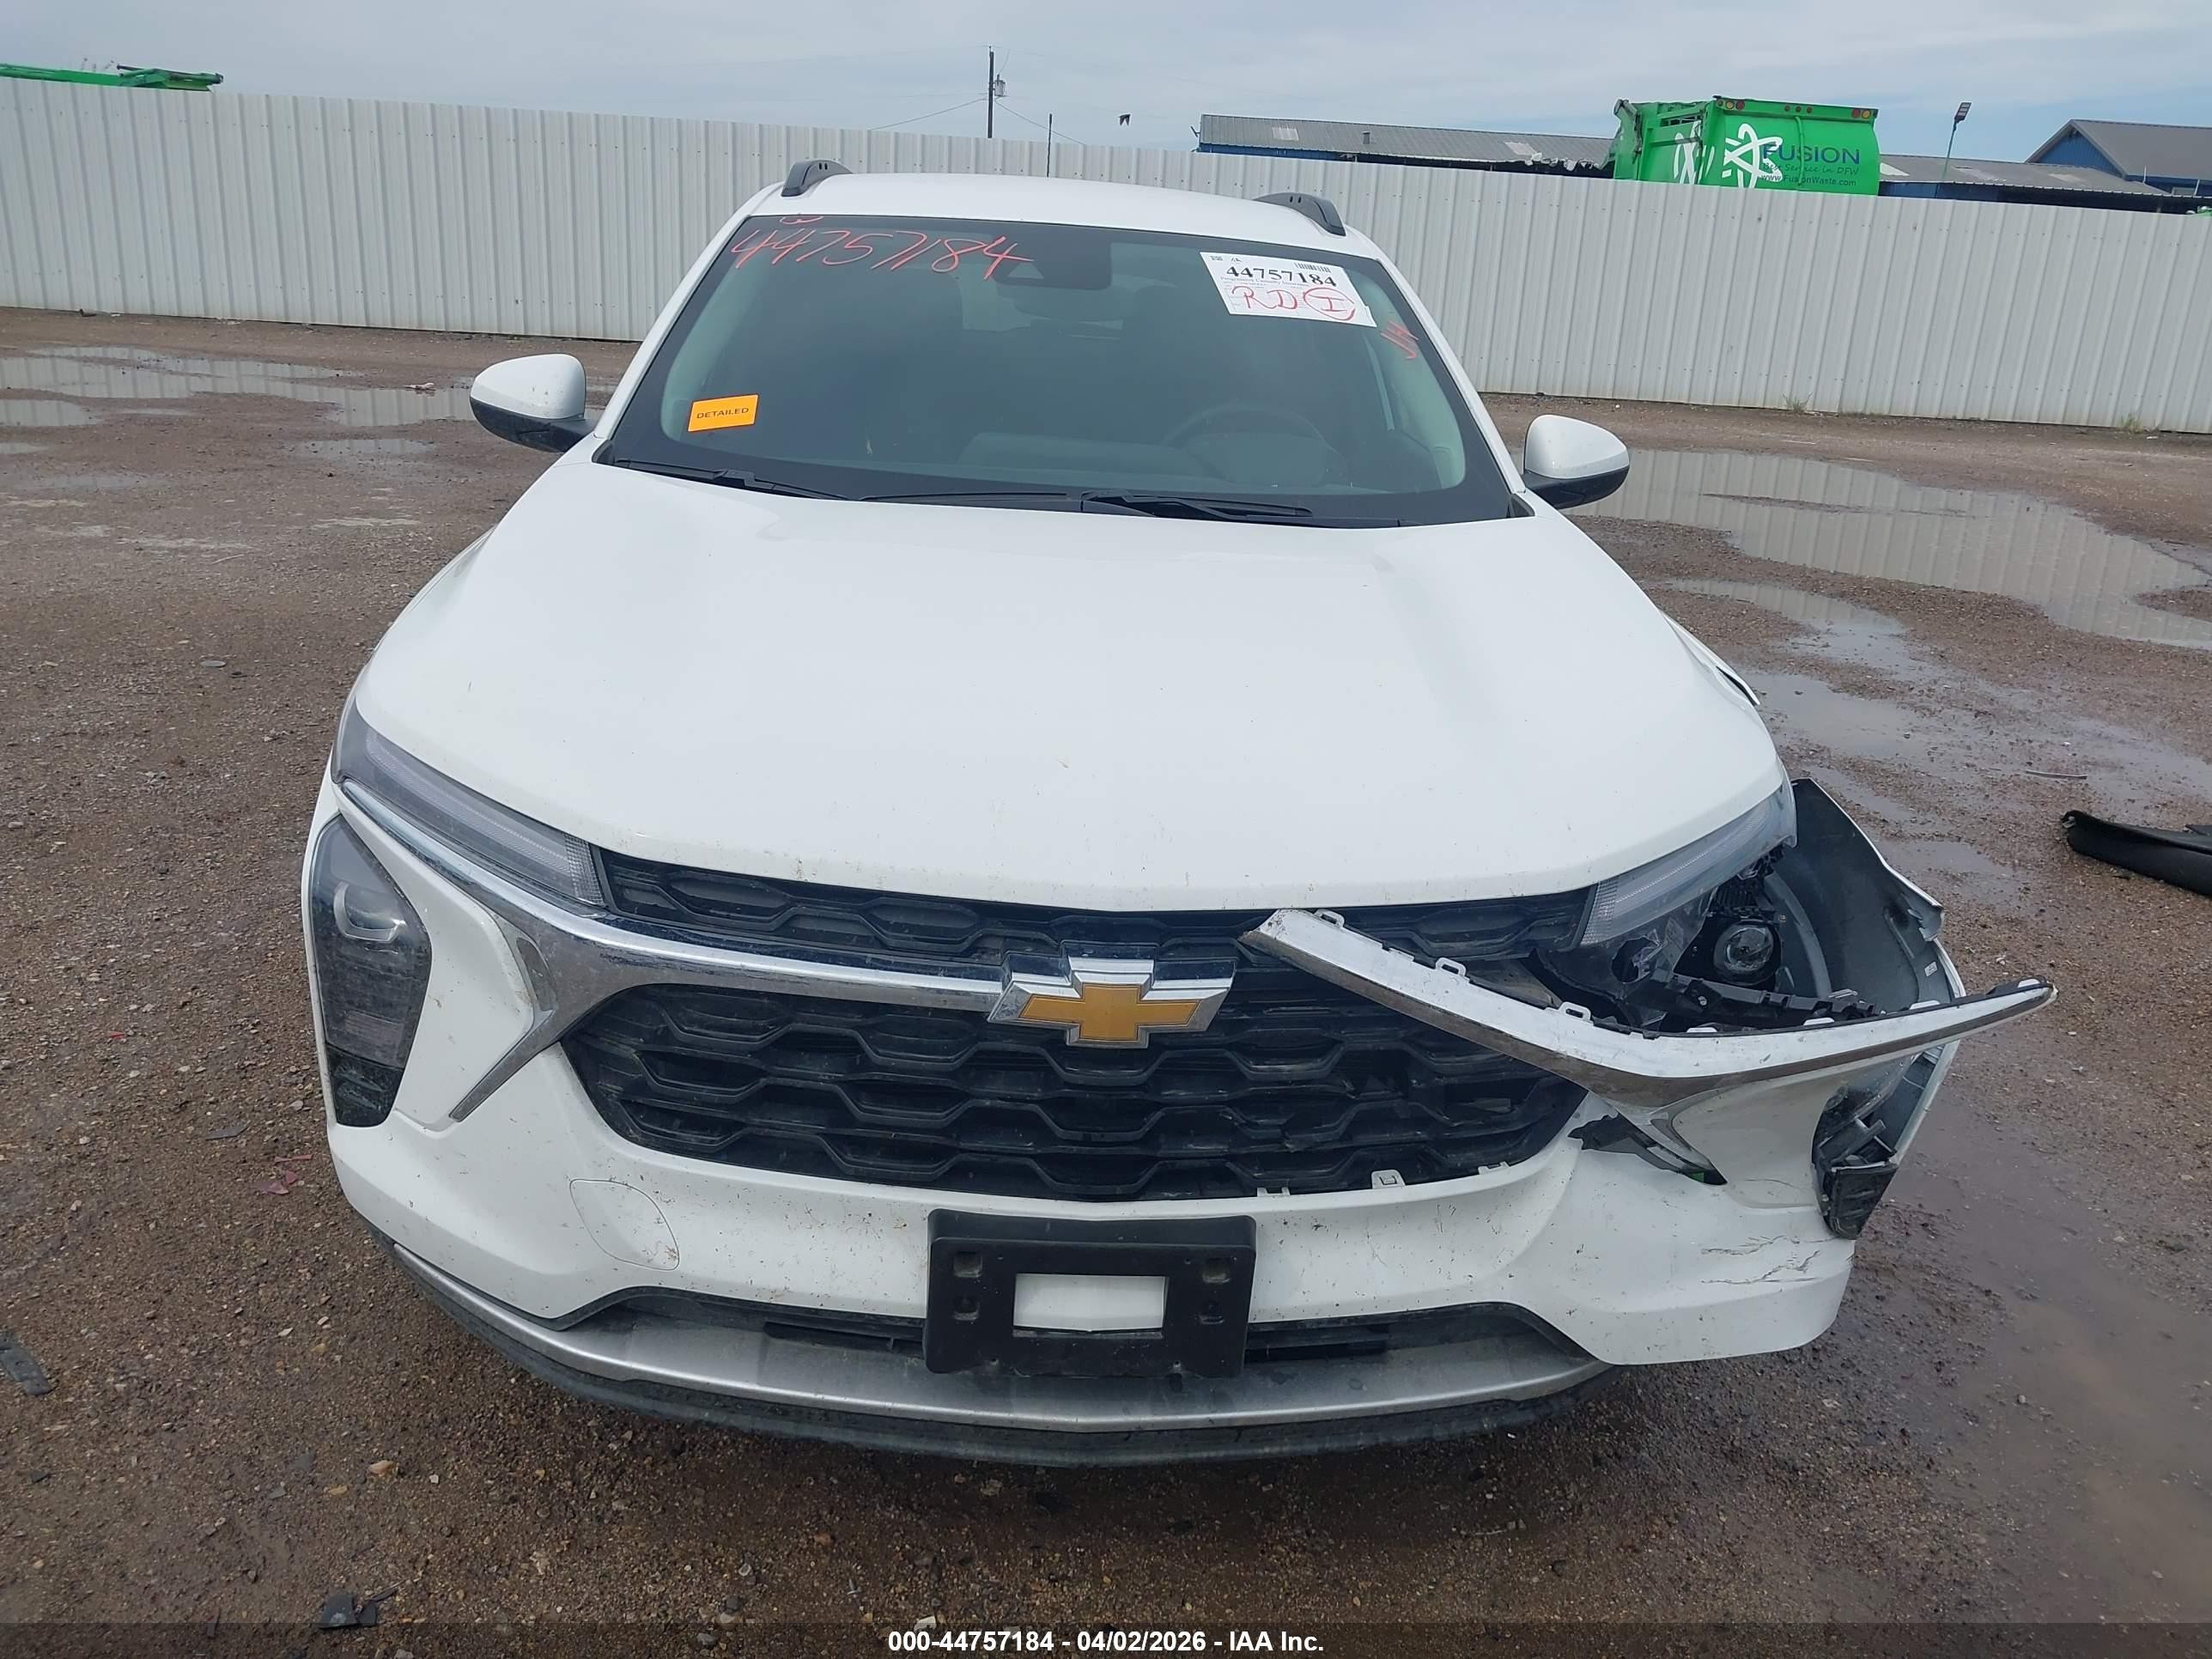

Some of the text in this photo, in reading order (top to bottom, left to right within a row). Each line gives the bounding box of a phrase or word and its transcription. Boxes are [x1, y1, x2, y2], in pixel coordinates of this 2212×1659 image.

[1763, 144, 1860, 165] FUSION
[1785, 163, 1819, 173] Serice
[1837, 167, 1859, 176] DFW
[731, 228, 1035, 280] 44757184
[1226, 265, 1337, 287] 44757184
[696, 407, 750, 419] DETAILED
